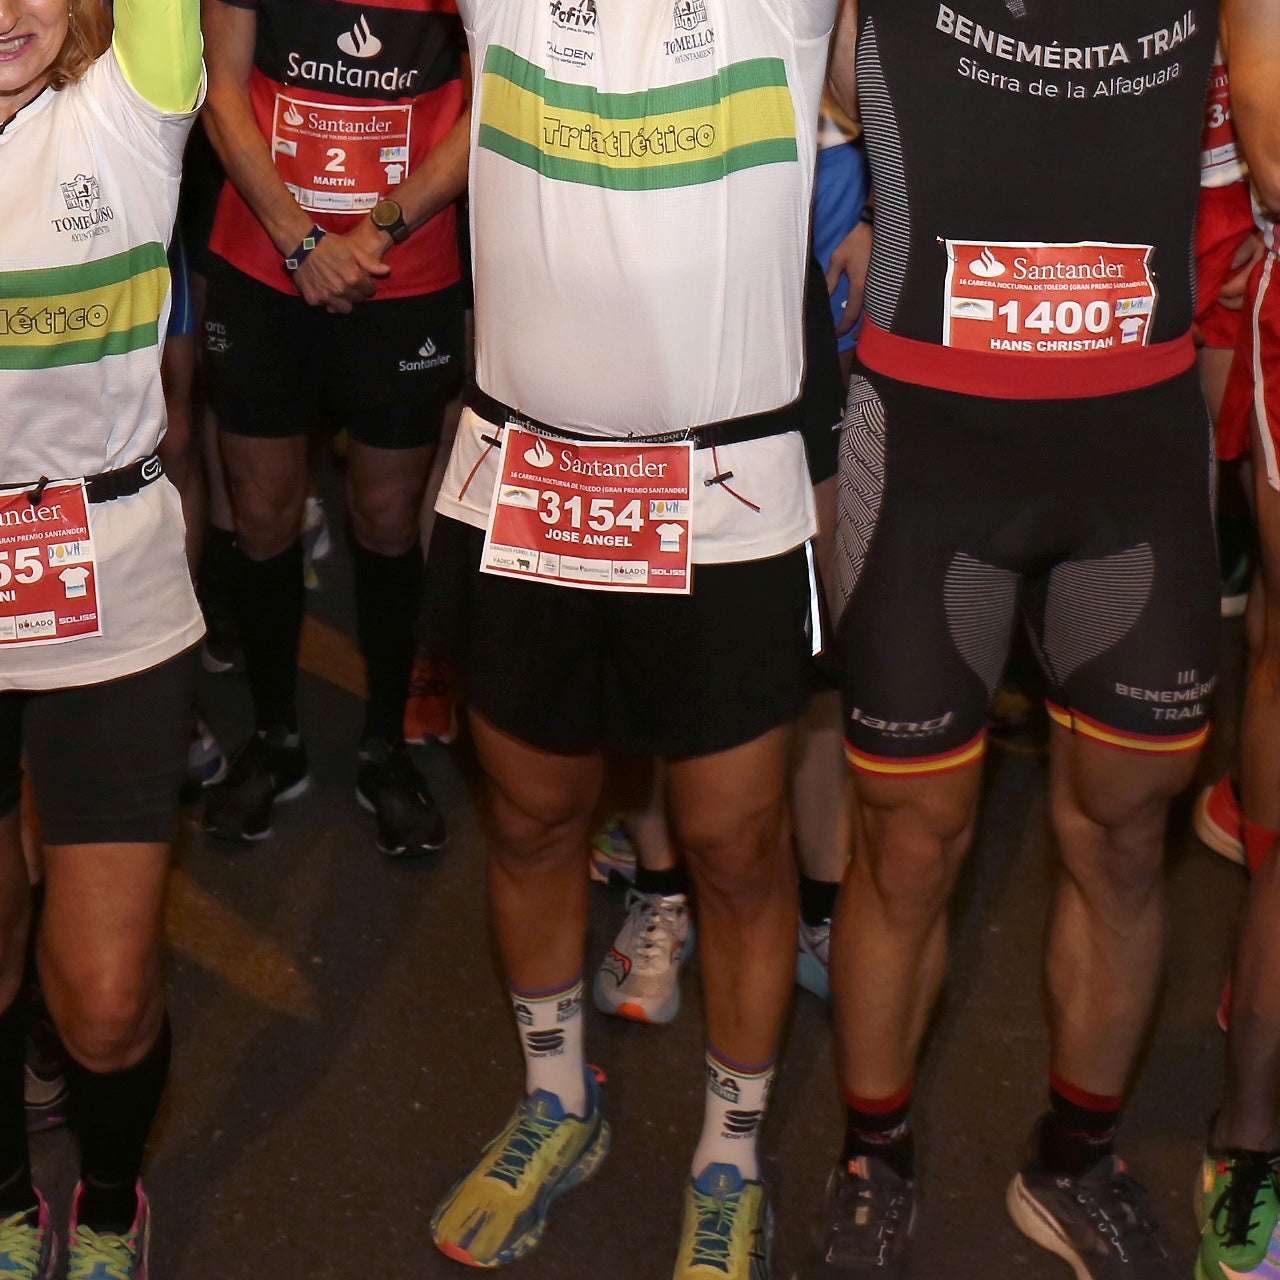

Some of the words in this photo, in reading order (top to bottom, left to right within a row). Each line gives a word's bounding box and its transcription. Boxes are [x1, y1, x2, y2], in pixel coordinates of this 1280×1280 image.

[935, 3, 1129, 69] BENEMÉRITA
[1137, 9, 1198, 59] TRAIL
[287, 52, 418, 91] Santander
[957, 57, 1021, 92] Sierra
[1028, 79, 1058, 98] de
[1066, 81, 1085, 98] la
[1093, 62, 1180, 98] Alfaguara
[308, 113, 392, 133] Santander
[544, 117, 715, 158] Triatlético
[325, 148, 346, 172] 2
[313, 176, 356, 187] MARTÍN
[1013, 255, 1124, 280] Santander
[968, 279, 996, 288] CARRERA
[997, 282, 1032, 290] NOCTURNA
[998, 300, 1110, 334] 1400
[990, 338, 1033, 351] HANS
[1037, 336, 1113, 352] CHRISTIAN
[559, 450, 667, 479] Santander
[542, 477, 570, 488] NOCTURNA
[579, 484, 601, 493] TOLEDO
[623, 486, 647, 494] PREMIO
[648, 487, 688, 495] SANTANDER)
[539, 490, 644, 533] 3154
[17, 532, 44, 543] PREMIO
[44, 526, 87, 538] SANTANDER)
[545, 528, 579, 542] JOSE
[583, 531, 632, 546] ANGEL
[614, 566, 646, 575] BOLADO
[651, 568, 685, 576] SOLISS
[18, 619, 53, 629] BOLADO
[59, 614, 96, 625] SOLISS
[1152, 704, 1204, 721] TRAIL
